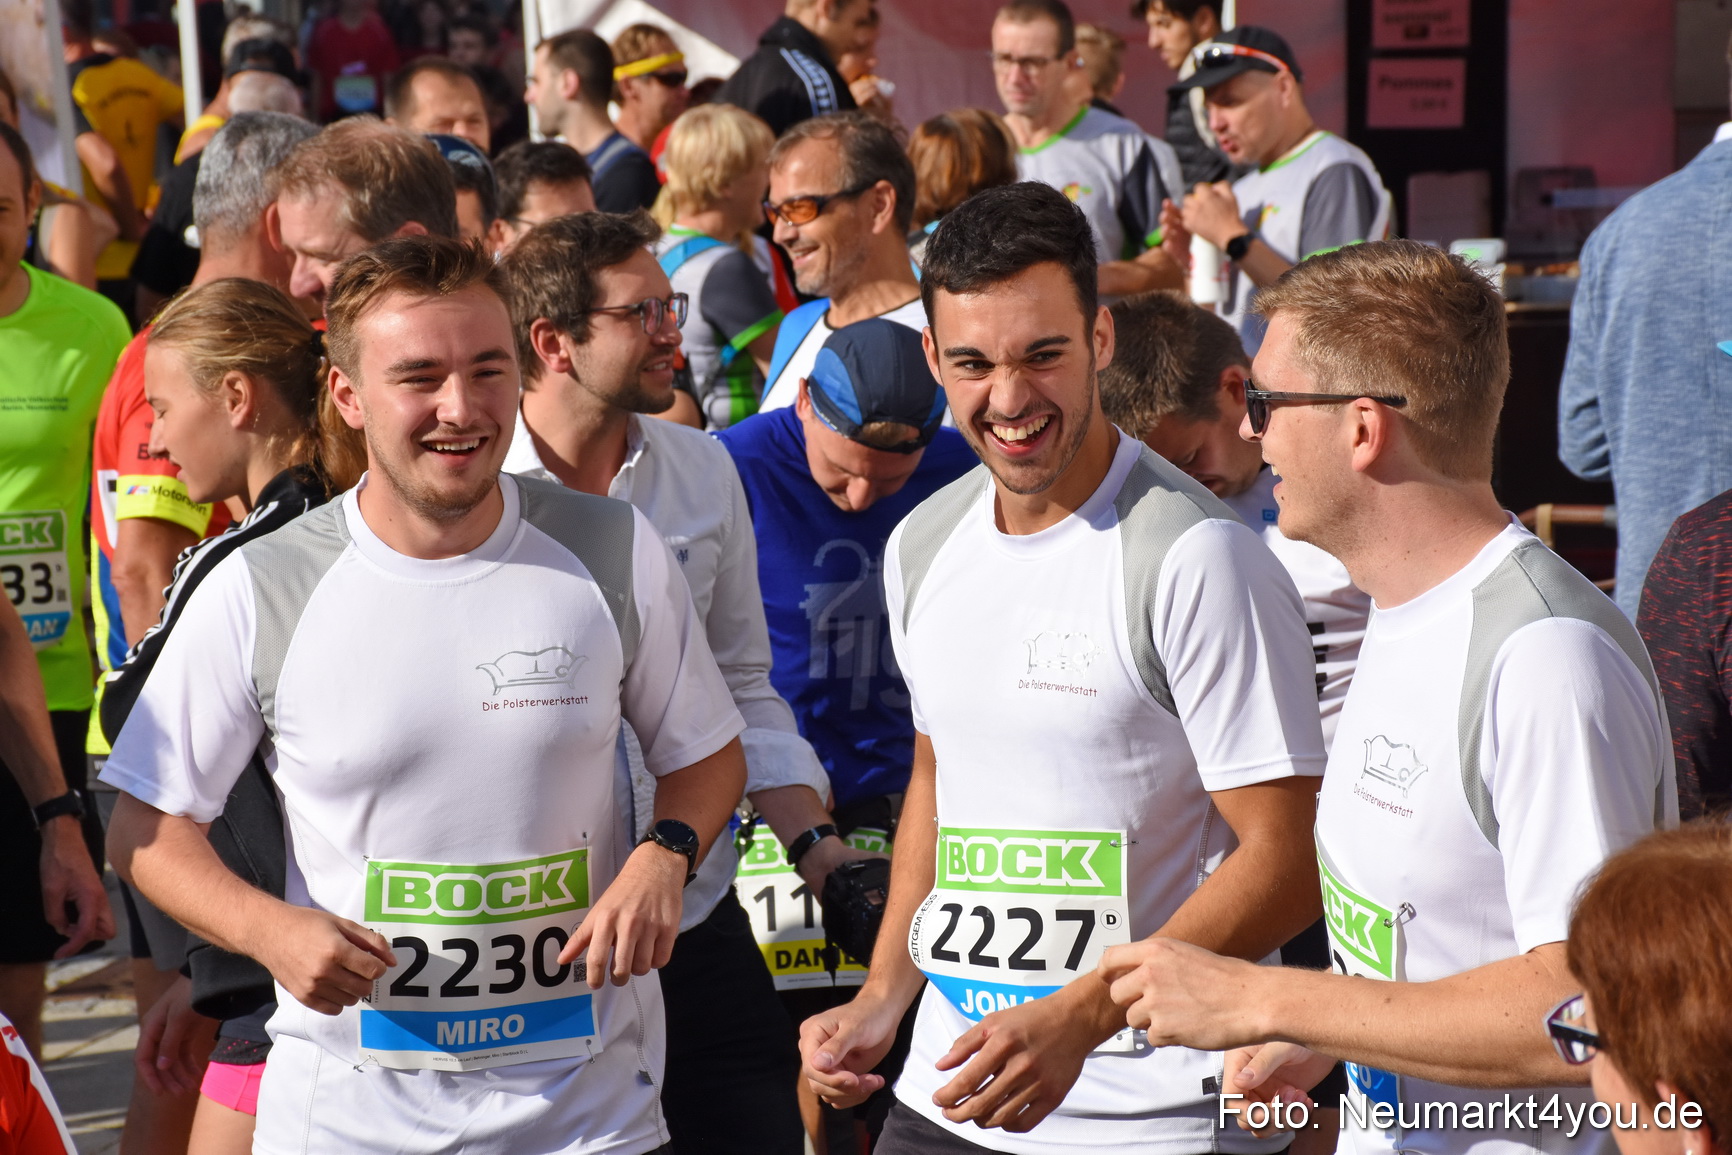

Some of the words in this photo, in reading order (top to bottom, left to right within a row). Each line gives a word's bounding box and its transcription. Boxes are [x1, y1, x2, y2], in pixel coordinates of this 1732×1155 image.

[482, 701, 500, 711] Die
[503, 696, 589, 709] Polsterwerkstatt
[1018, 679, 1030, 689] Die
[1031, 680, 1097, 697] Polsterwerkstatt
[1353, 783, 1361, 795] Die
[1360, 787, 1414, 818] Polsterwerkstatt
[946, 836, 1102, 886] BOCK
[384, 862, 575, 916] BOCK
[930, 902, 1096, 971] 2227
[1106, 914, 1117, 925] D
[389, 926, 572, 997] 2230
[436, 1013, 525, 1046] MIRO
